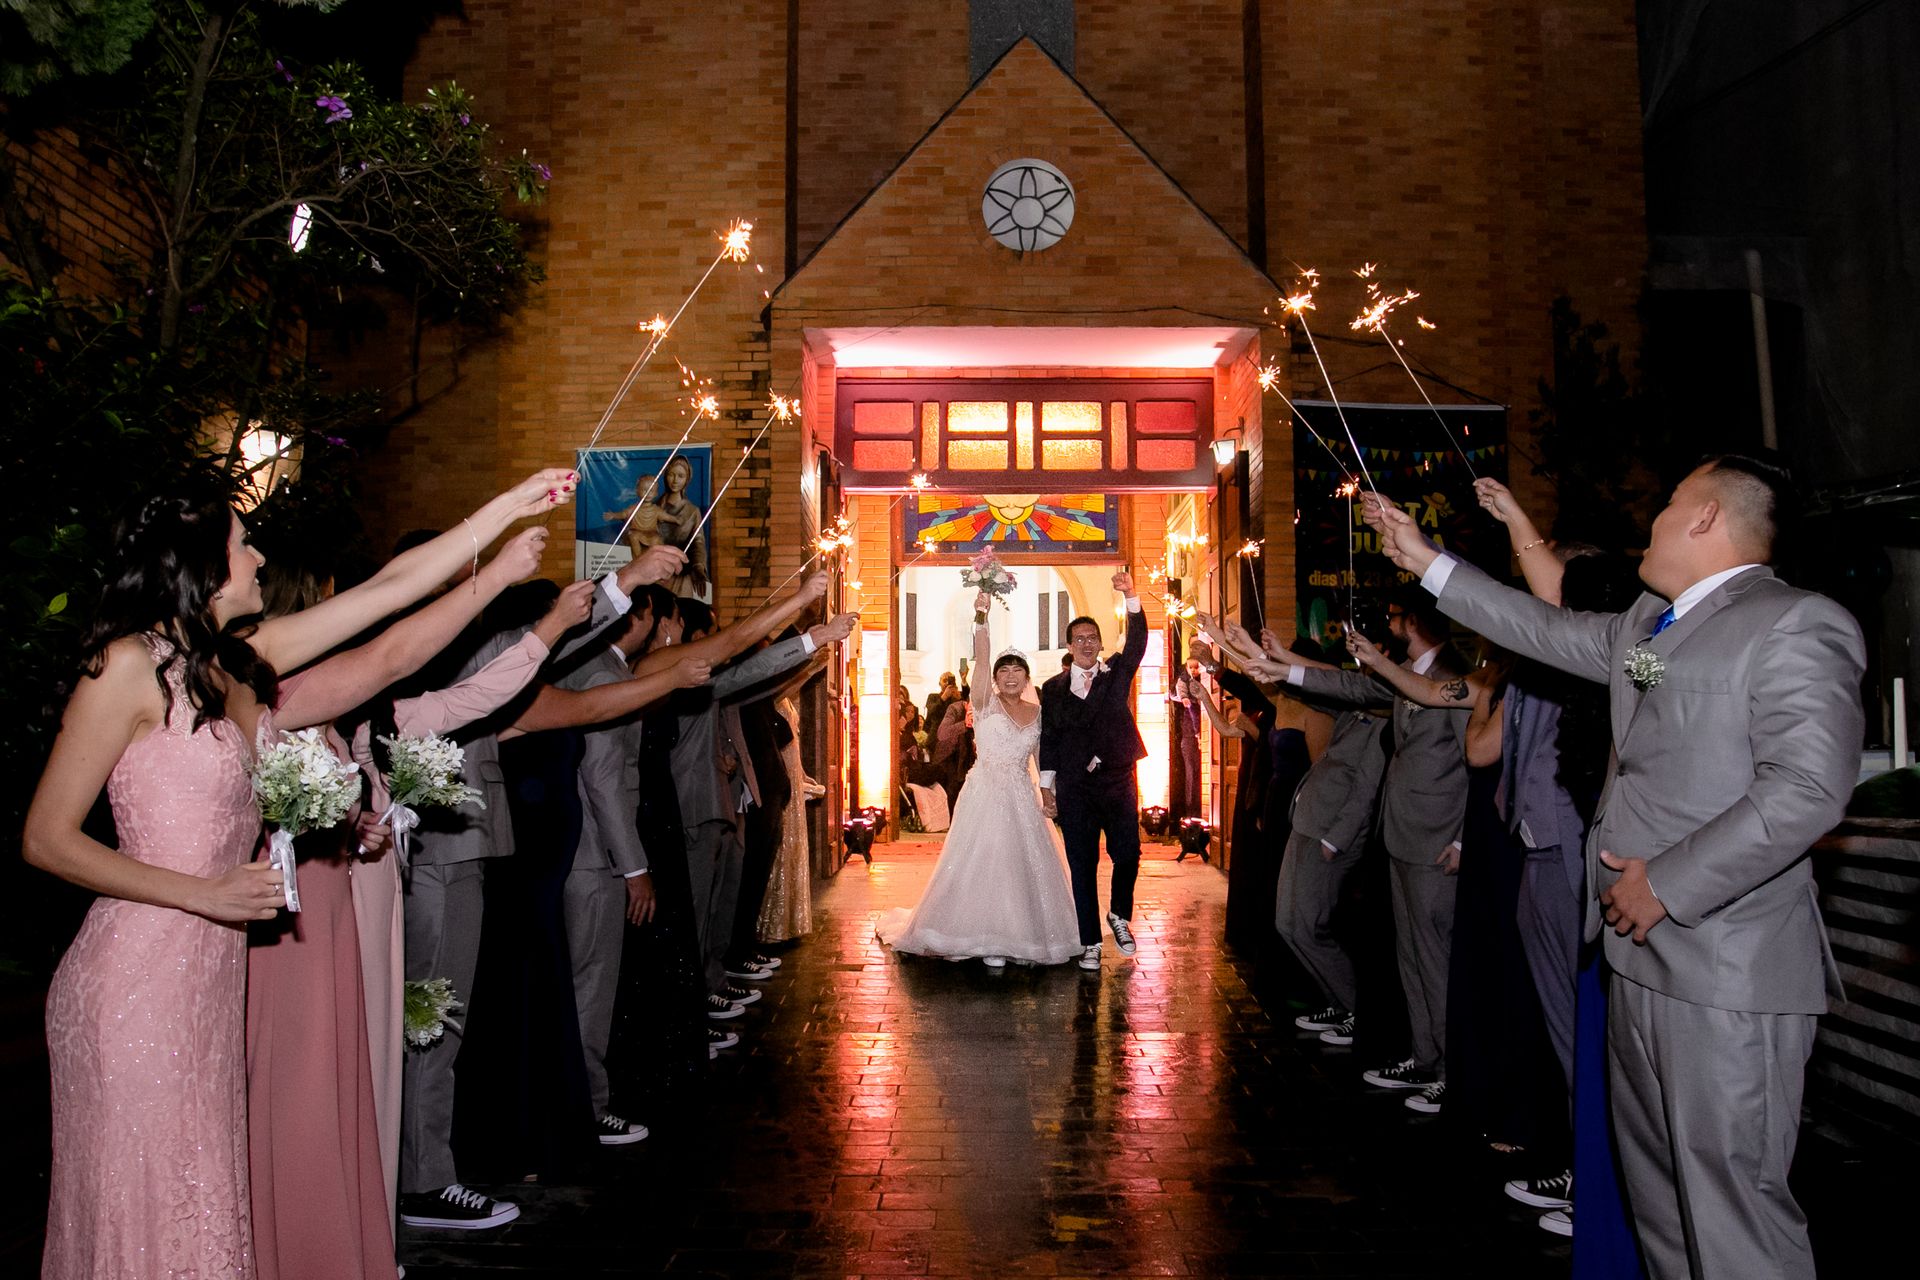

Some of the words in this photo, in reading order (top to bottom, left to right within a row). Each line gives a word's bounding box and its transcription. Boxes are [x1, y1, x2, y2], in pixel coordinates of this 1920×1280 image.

[1352, 501, 1439, 528] FTA
[1349, 531, 1445, 554] JUA
[1309, 569, 1337, 587] dias
[1340, 569, 1361, 590] 16,
